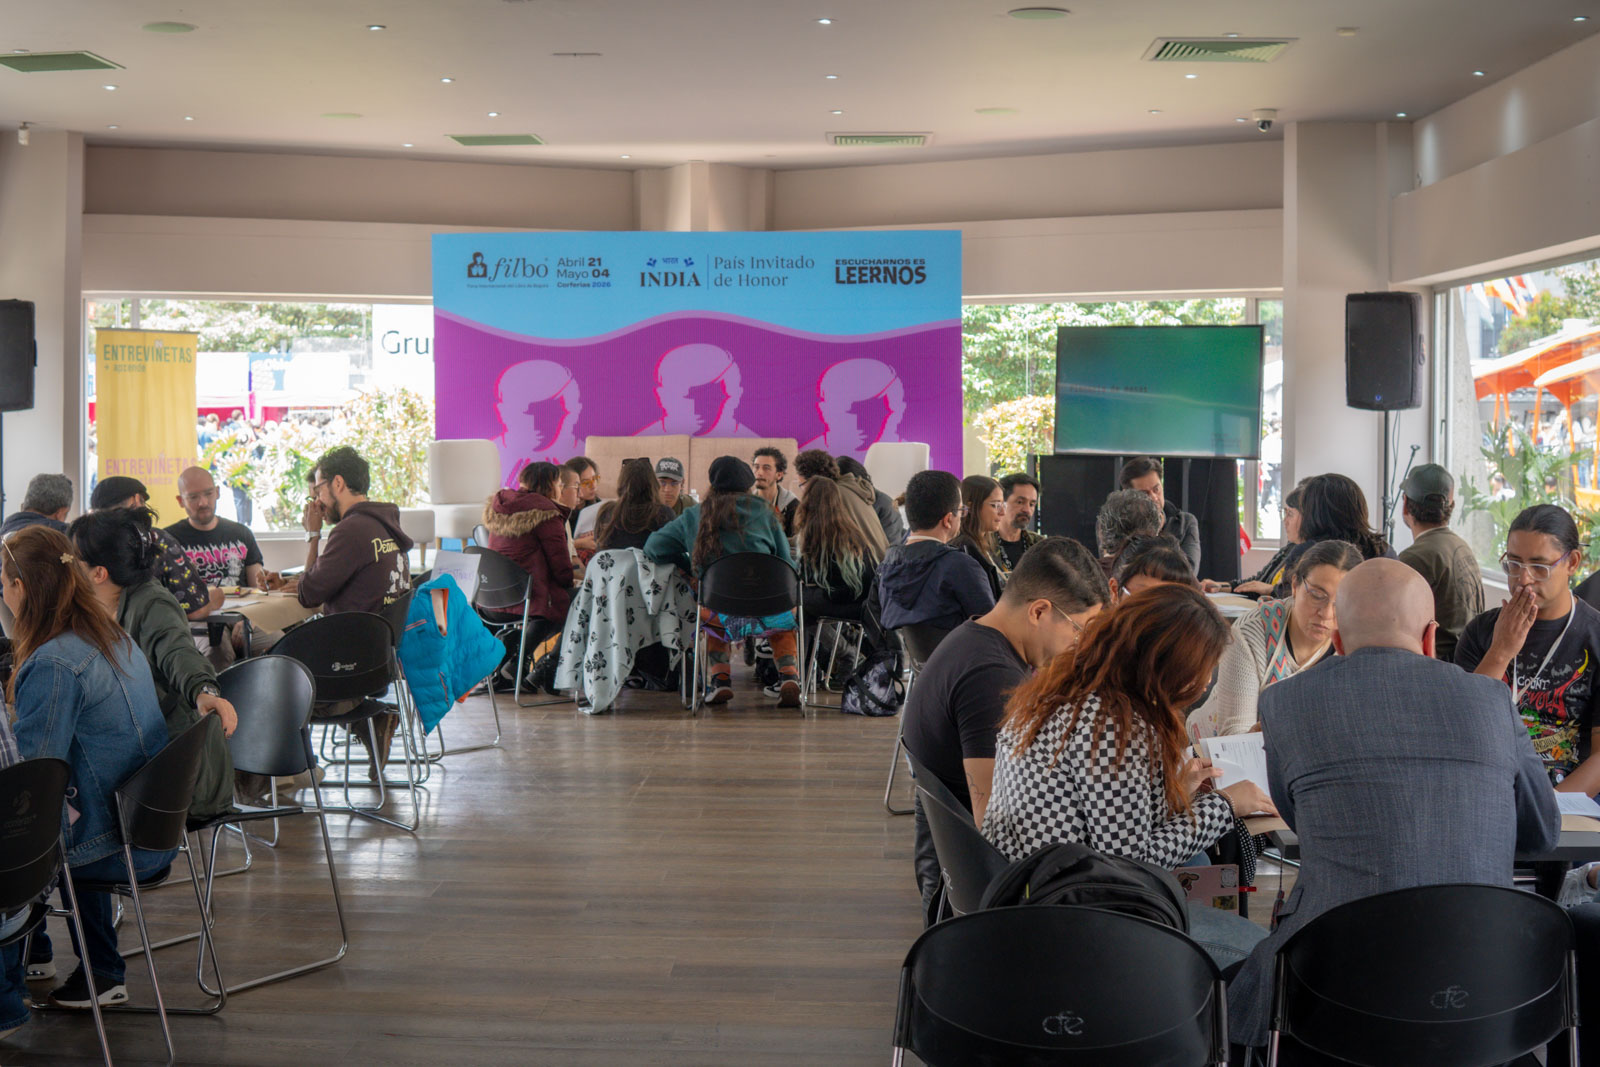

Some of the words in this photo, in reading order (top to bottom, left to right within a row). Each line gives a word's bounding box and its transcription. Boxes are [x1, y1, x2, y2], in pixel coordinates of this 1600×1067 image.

[557, 256, 585, 267] Abril
[588, 256, 602, 267] 21
[714, 256, 745, 269] País
[750, 255, 815, 269] Invitado
[488, 257, 549, 282] filbo
[556, 268, 589, 281] Mayo
[592, 268, 610, 278] 04
[835, 266, 927, 285] LEERNOS
[640, 271, 702, 287] INDIA
[713, 273, 733, 287] de
[738, 273, 788, 287] Honor
[382, 330, 432, 356] Gru
